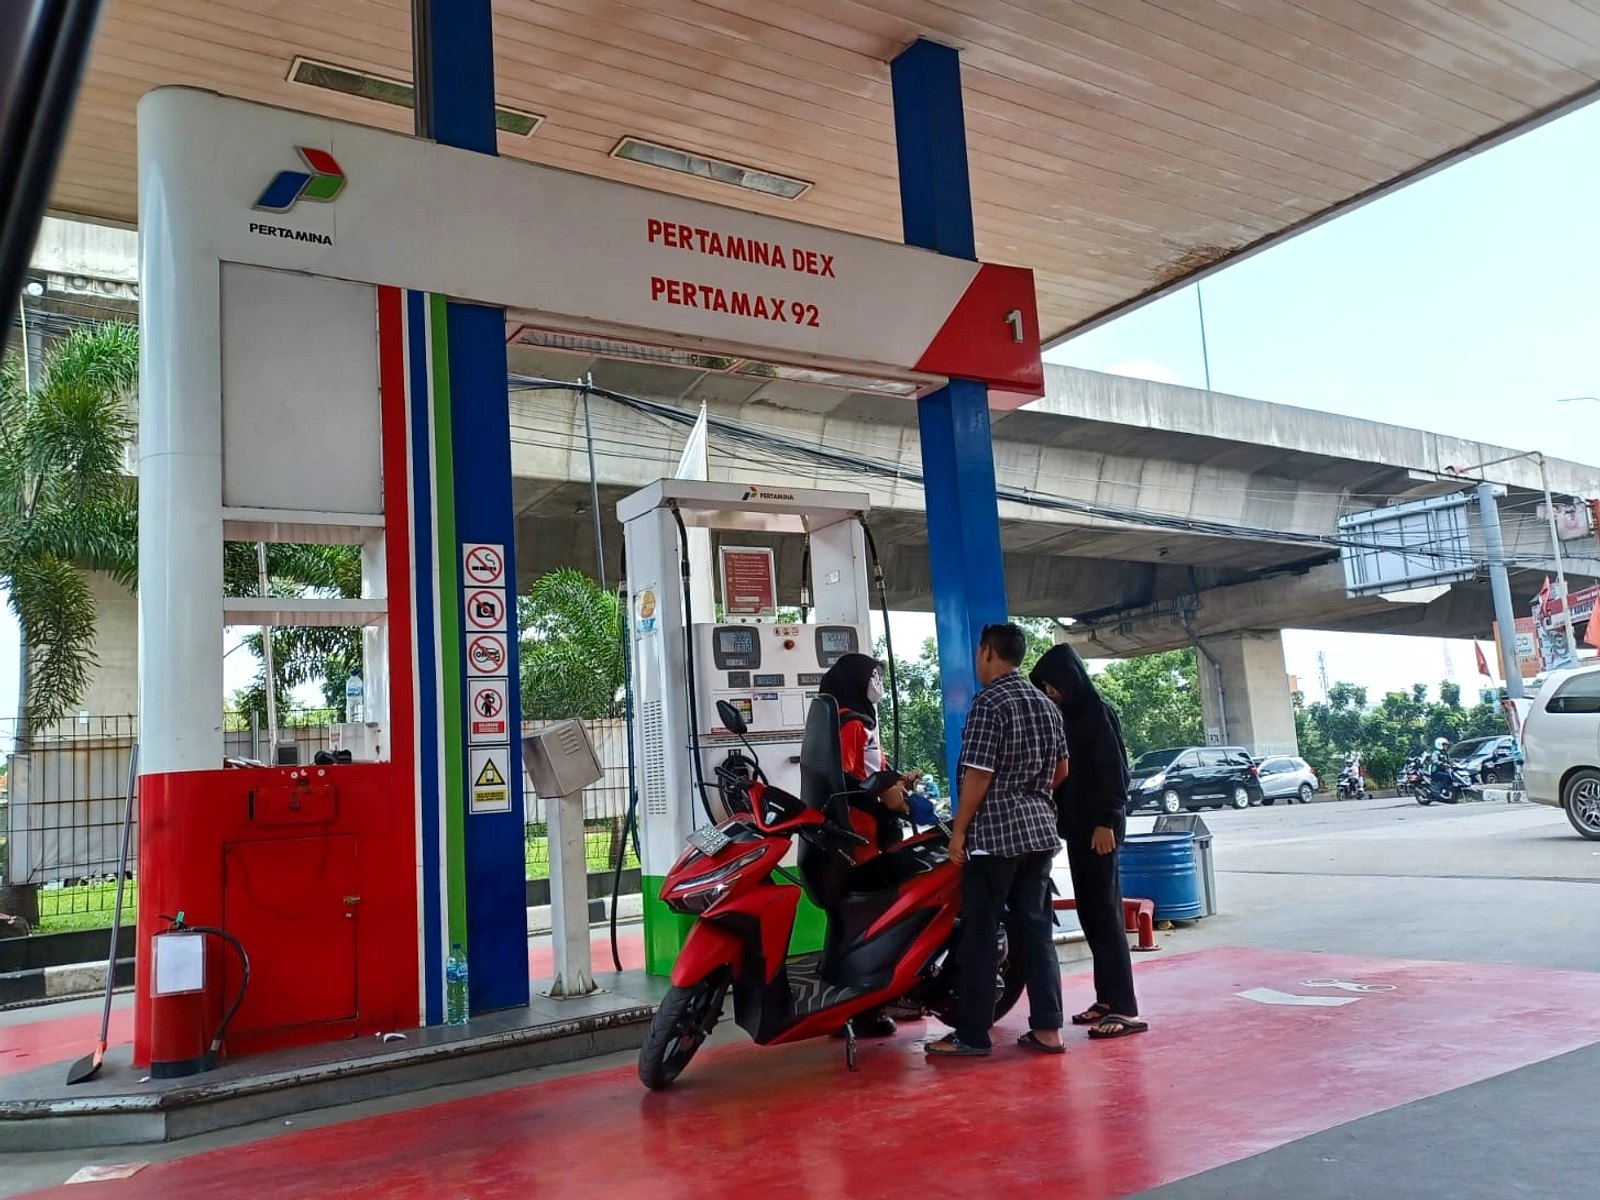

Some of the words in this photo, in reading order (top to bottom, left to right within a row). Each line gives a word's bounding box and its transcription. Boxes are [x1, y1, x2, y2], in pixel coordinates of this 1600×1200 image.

[249, 223, 333, 246] PERTAMINA
[647, 218, 787, 269] PERTAMINA
[792, 248, 836, 279] DEX
[650, 276, 787, 323] PERTAMAX
[790, 301, 820, 328] 92
[1004, 309, 1024, 344] 1
